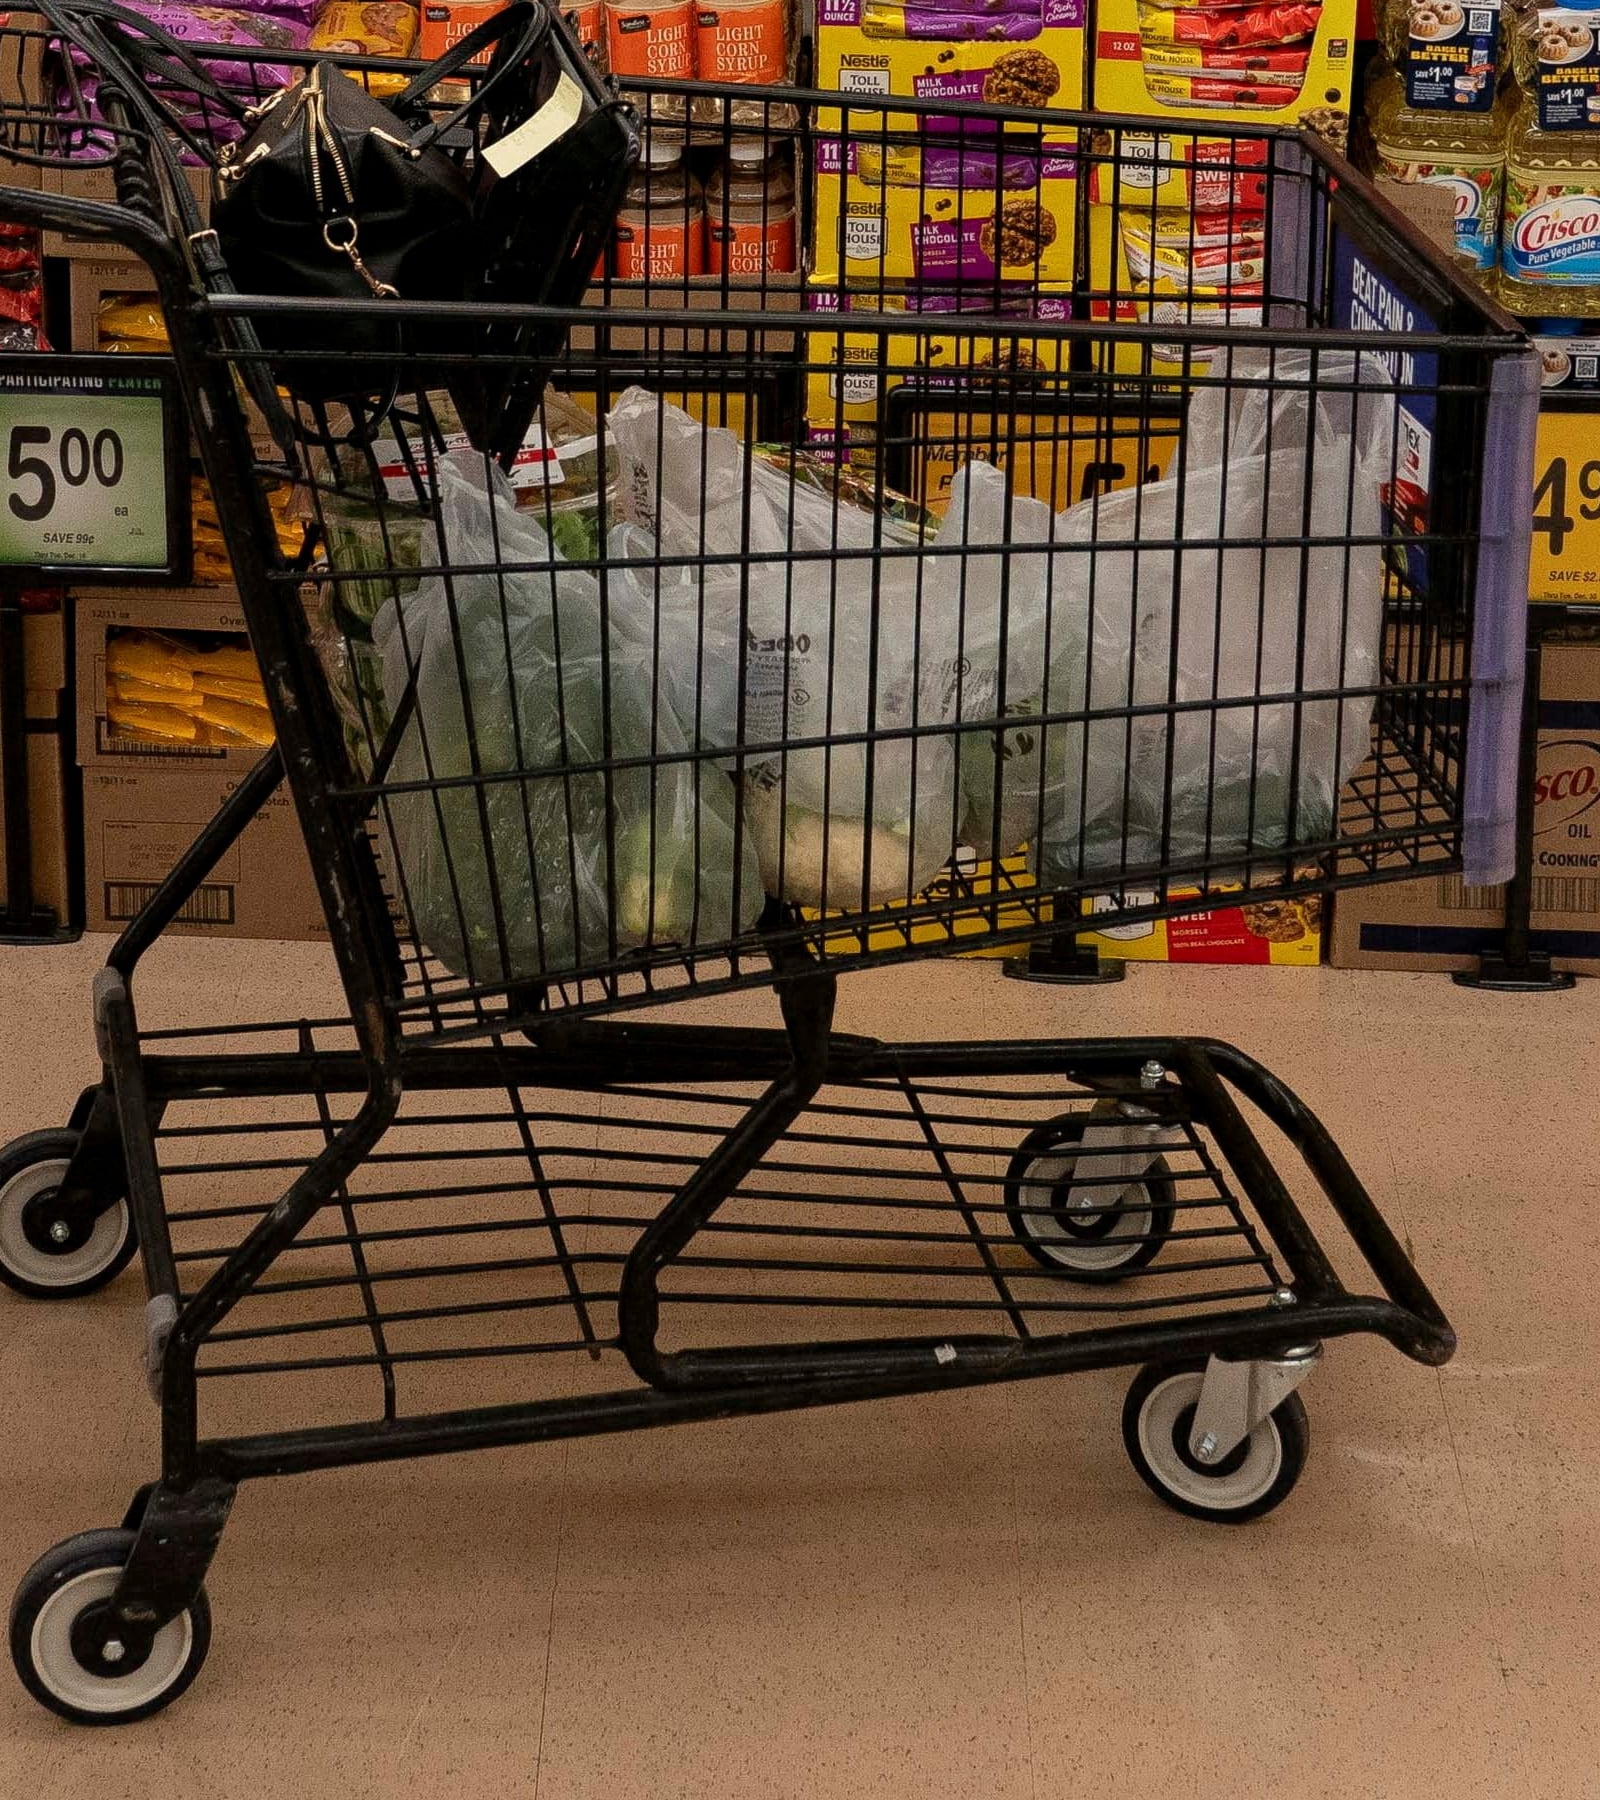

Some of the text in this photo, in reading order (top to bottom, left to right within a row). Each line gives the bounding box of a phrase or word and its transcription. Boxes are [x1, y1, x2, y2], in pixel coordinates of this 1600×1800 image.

[823, 10, 857, 22] OUNCE
[715, 24, 765, 44] LIGHT
[716, 41, 761, 58] CORN
[715, 54, 768, 75] SYRUP
[917, 78, 944, 90] MILK
[1521, 211, 1600, 252] Crisco
[1528, 241, 1597, 264] Pure Vegetable
[43, 533, 74, 544] SAVE
